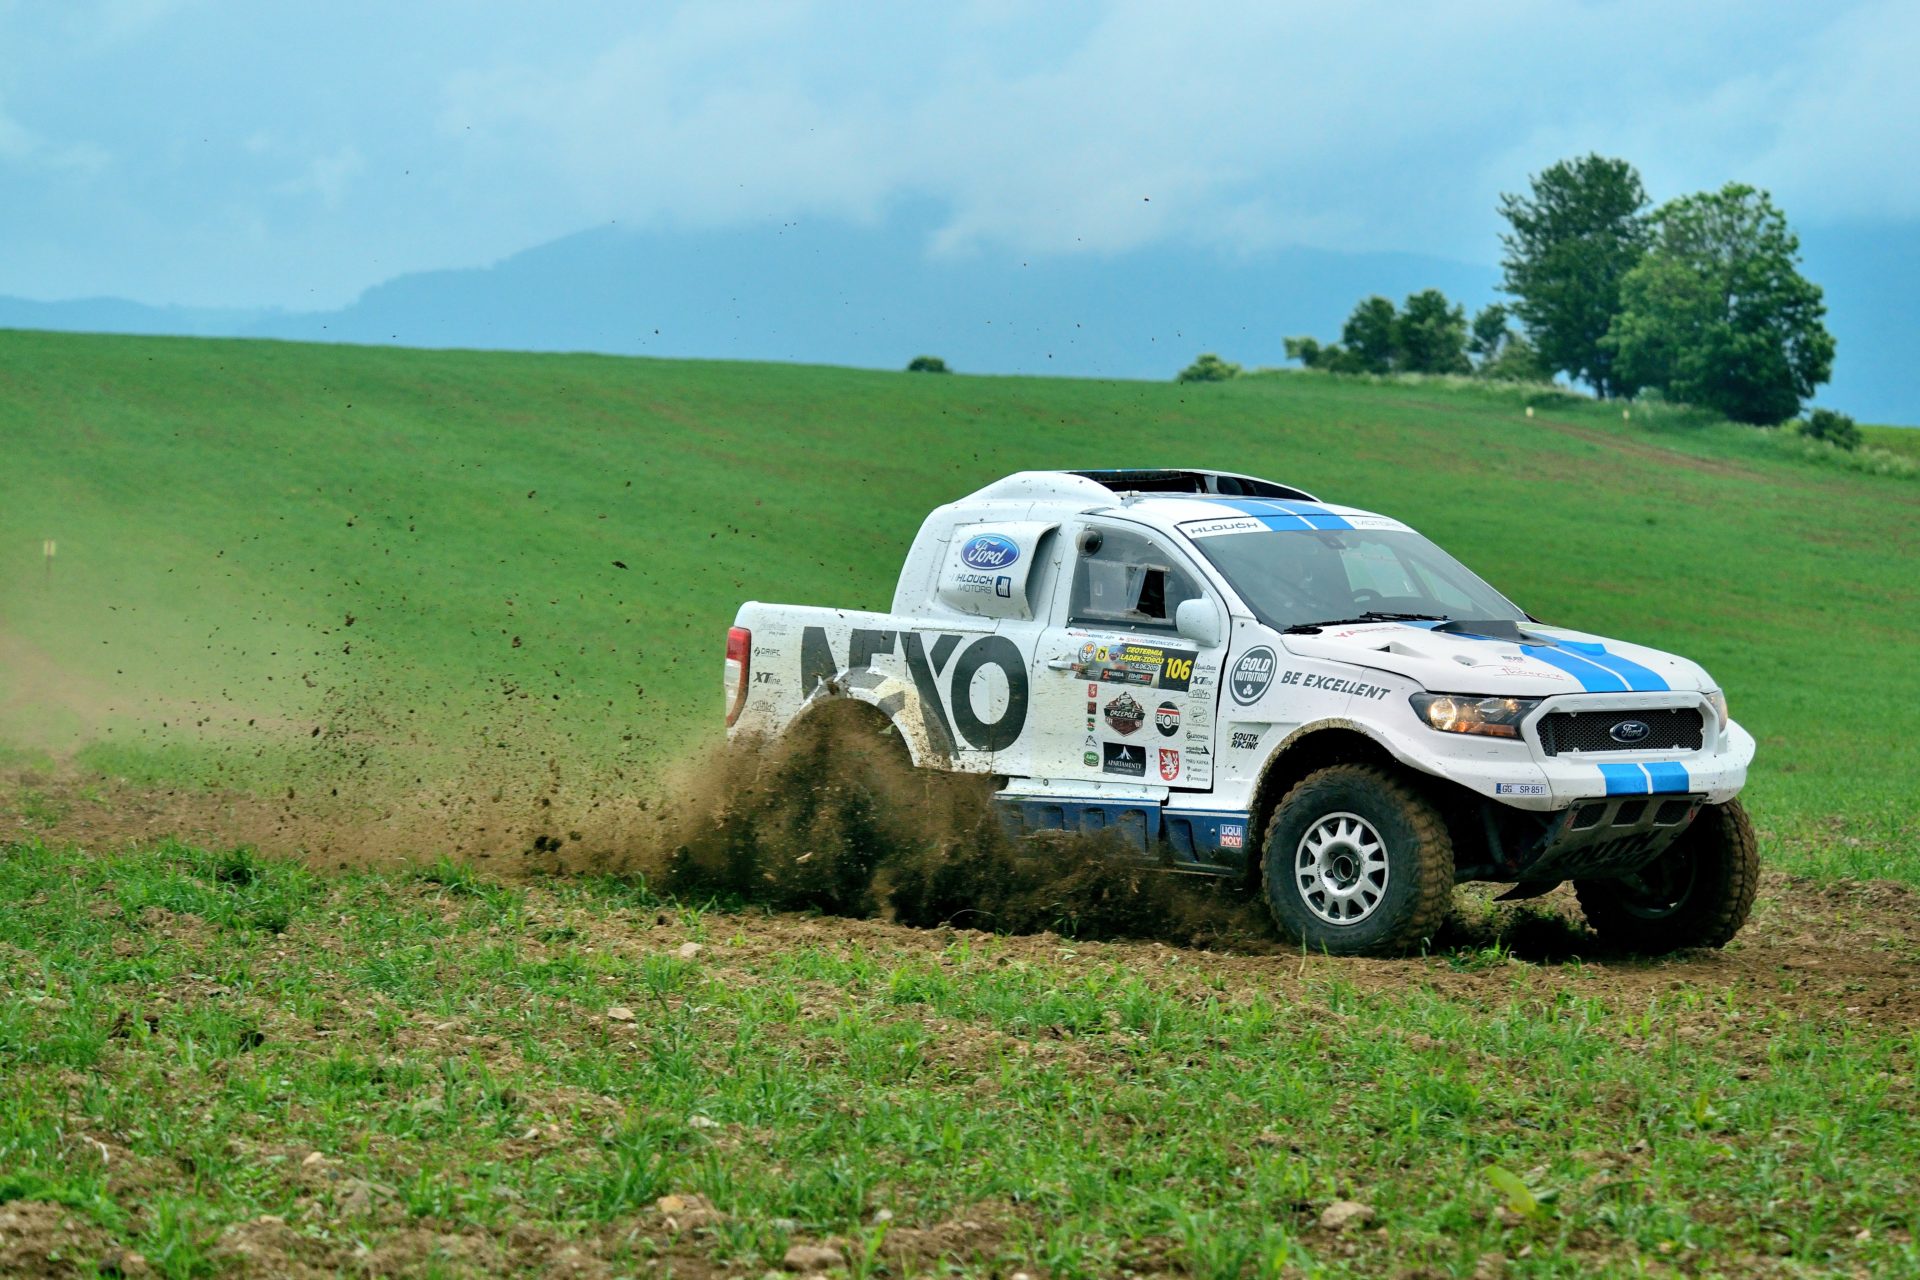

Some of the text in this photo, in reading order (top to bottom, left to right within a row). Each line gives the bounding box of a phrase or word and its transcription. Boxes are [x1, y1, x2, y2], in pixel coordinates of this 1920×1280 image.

[1190, 521, 1258, 534] HLOUCH
[967, 537, 1008, 565] Ford
[956, 574, 994, 585] HLOUCH
[957, 584, 992, 594] MOTORS
[1126, 646, 1163, 656] GEOTERMIA
[1165, 657, 1193, 681] 106
[1240, 657, 1272, 672] GOLD
[1235, 671, 1269, 683] NUTRITION
[1280, 670, 1391, 701] BE EXCELLENT
[1156, 713, 1180, 728] ETOLL
[1621, 723, 1644, 738] Ford
[1231, 732, 1259, 742] SOUTH
[1107, 759, 1142, 770] APARTAMENTY
[1519, 785, 1530, 794] SR
[1531, 786, 1543, 794] 851
[1221, 825, 1241, 836] LIQUI
[1221, 835, 1241, 847] MOLY
